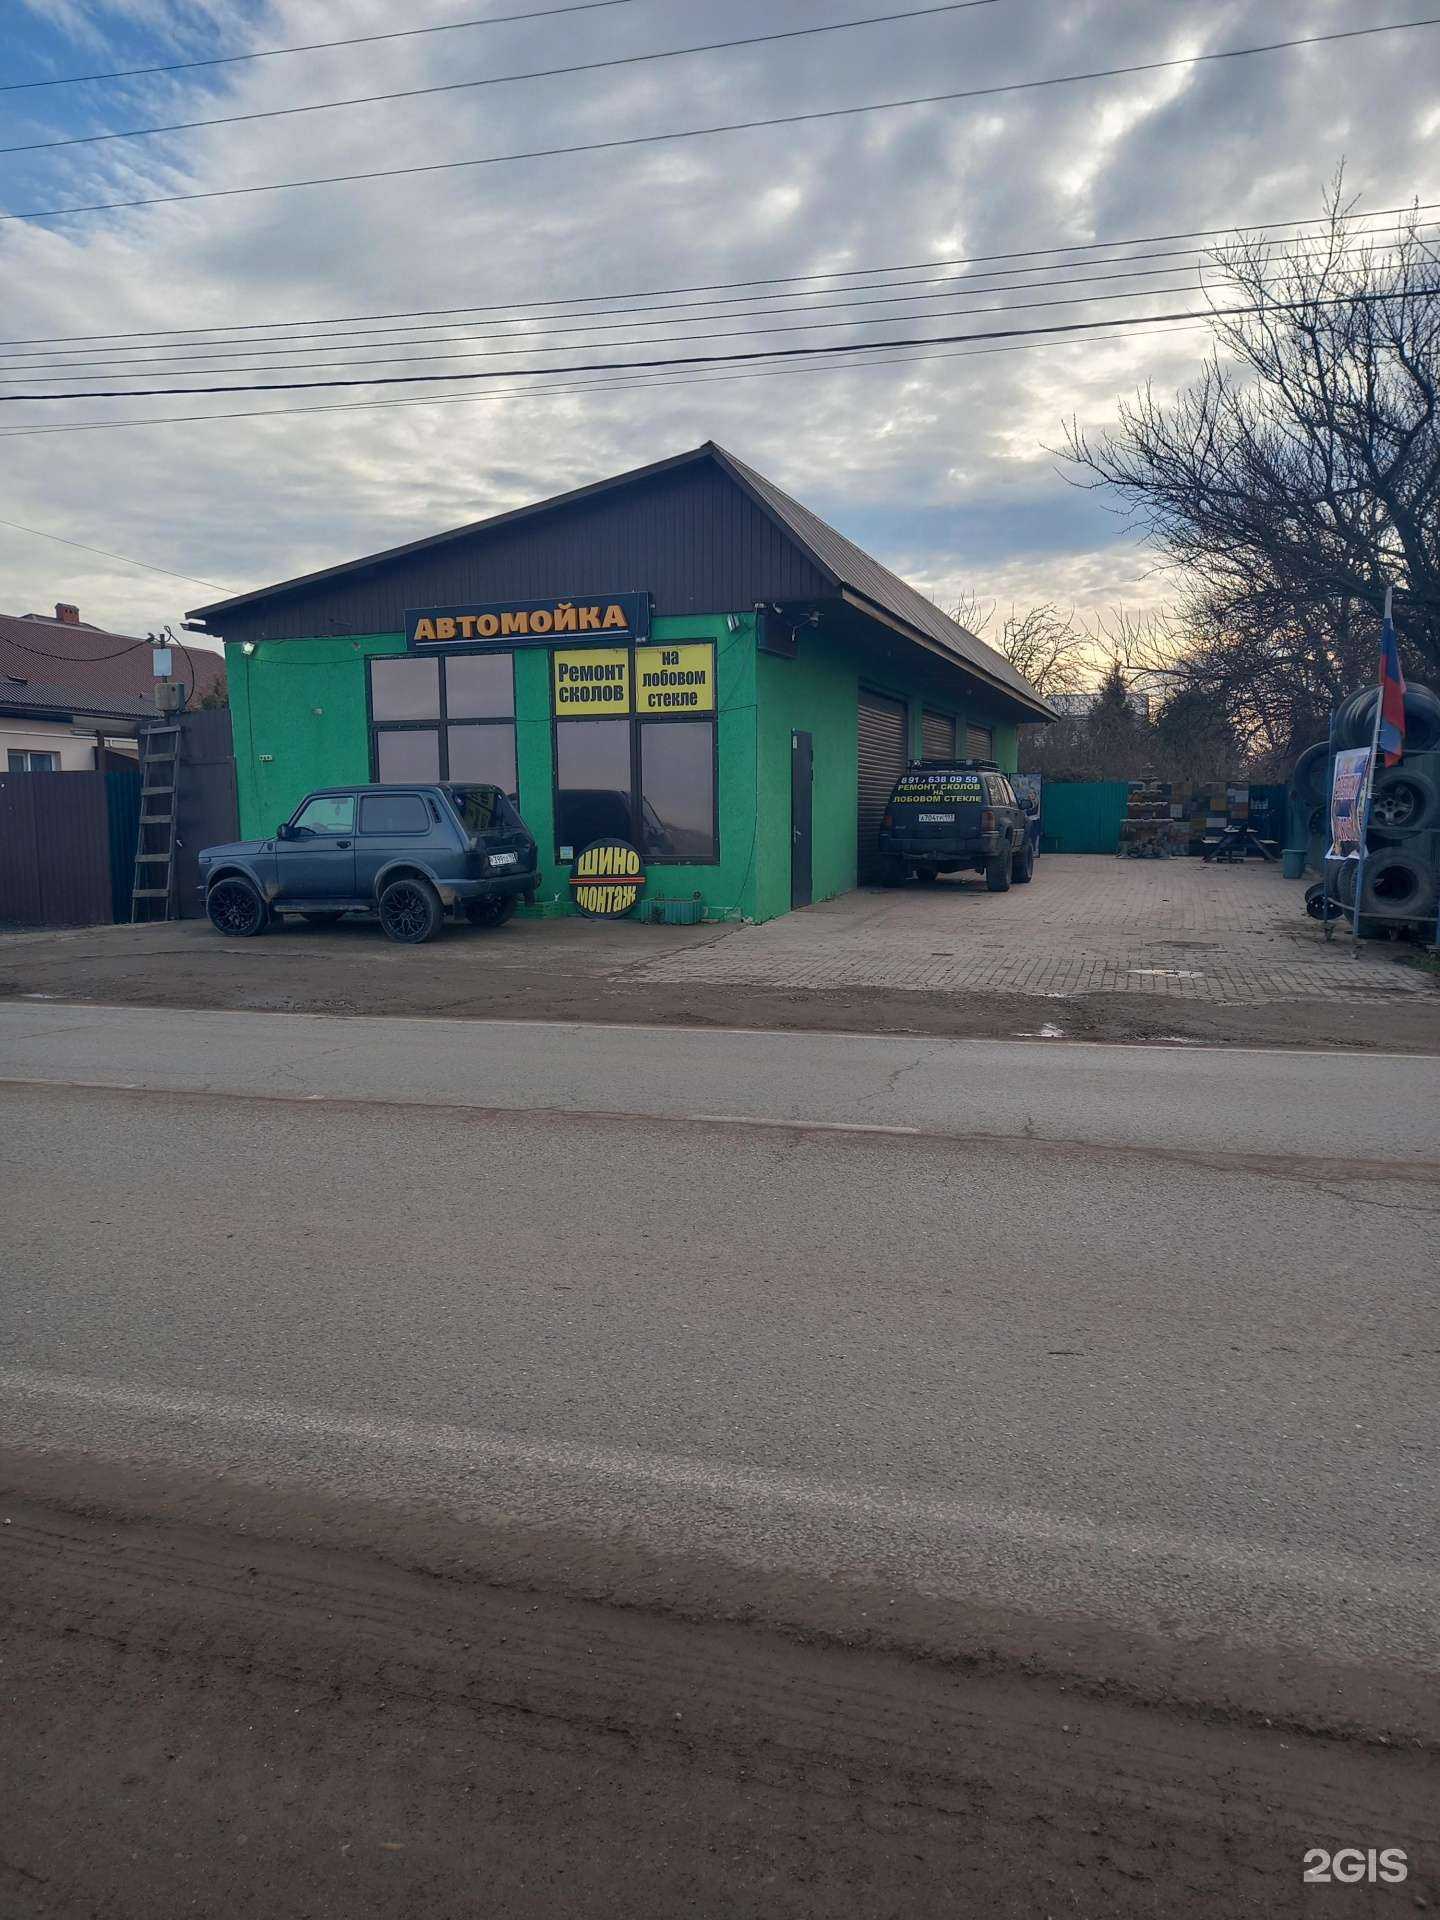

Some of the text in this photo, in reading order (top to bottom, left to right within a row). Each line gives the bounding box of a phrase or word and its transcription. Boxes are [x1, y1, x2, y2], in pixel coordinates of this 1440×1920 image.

[414, 602, 628, 640] АВТОМОЙКА
[662, 651, 679, 665] на
[558, 663, 625, 682] Ремонт
[642, 669, 706, 687] лобовом
[558, 685, 624, 702] сколов
[647, 691, 698, 707] стекле
[898, 783, 938, 791] РЕМОНТ
